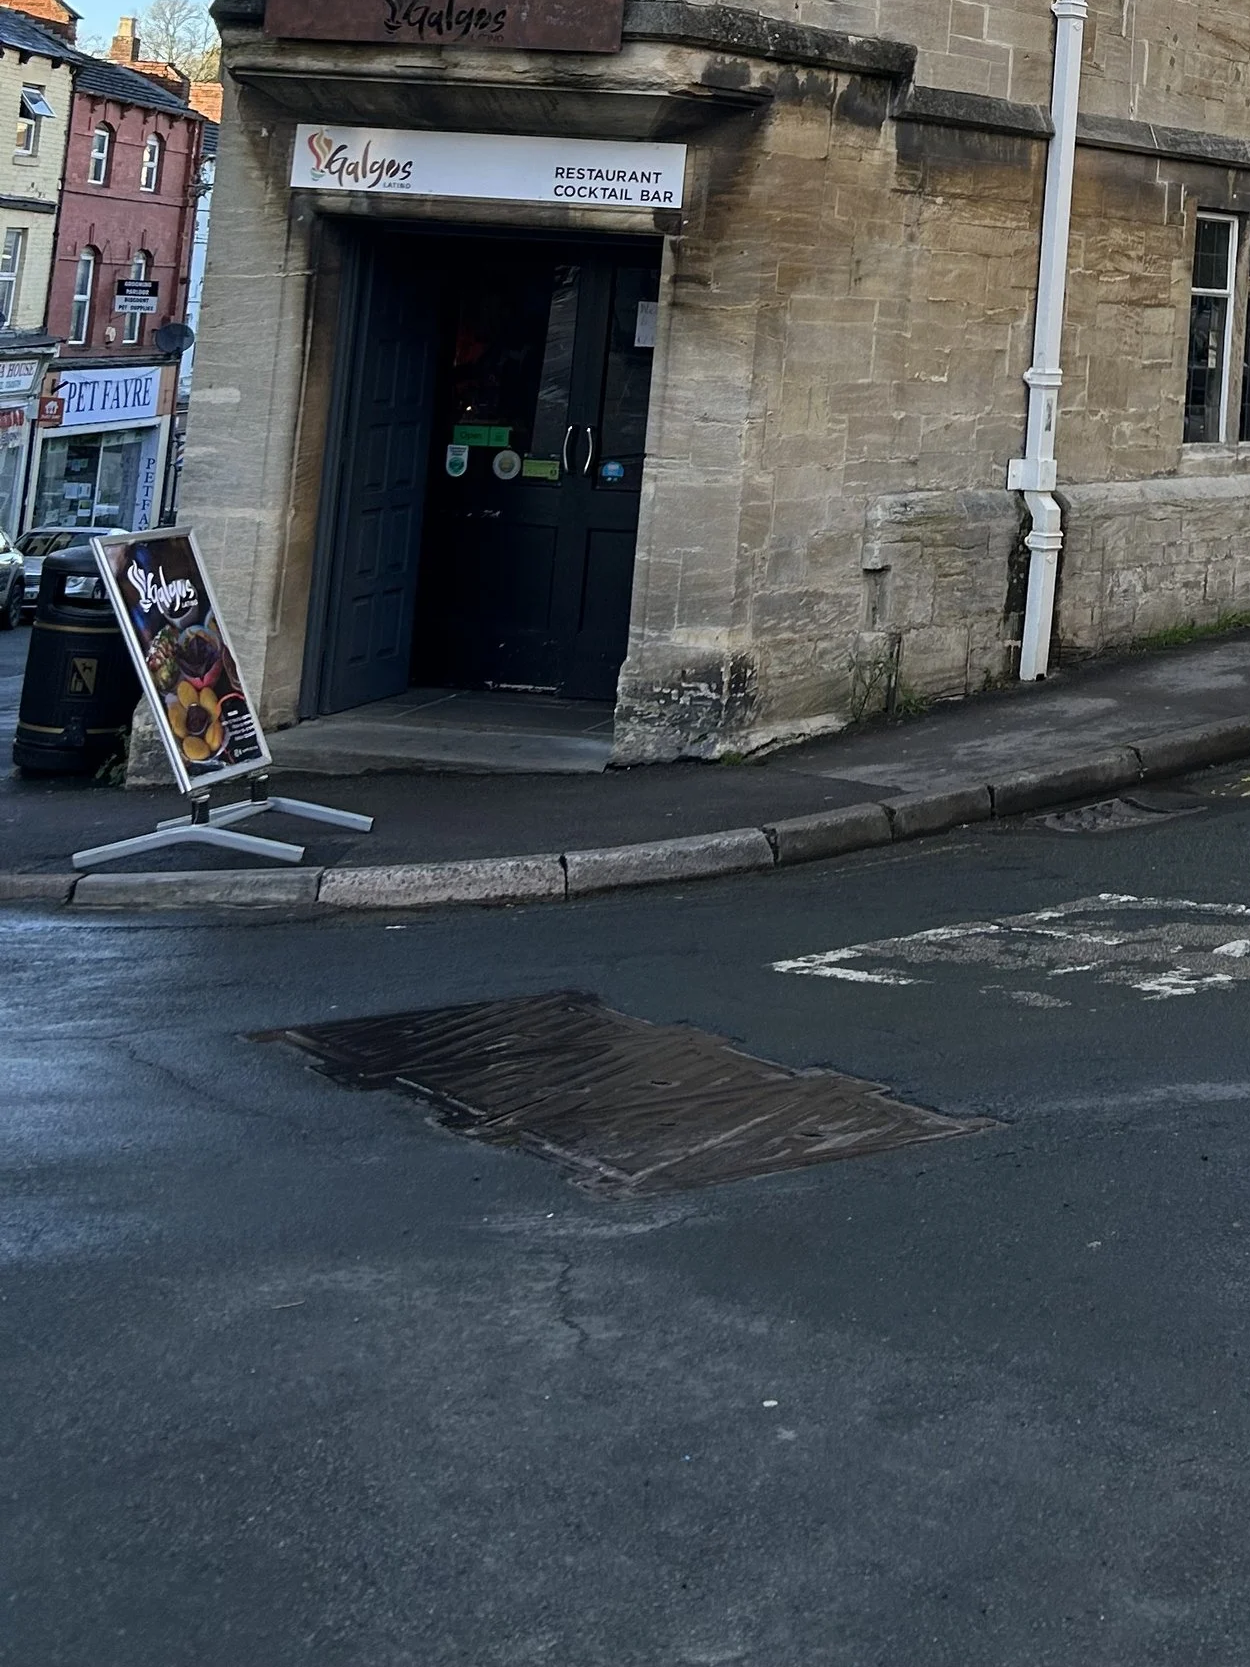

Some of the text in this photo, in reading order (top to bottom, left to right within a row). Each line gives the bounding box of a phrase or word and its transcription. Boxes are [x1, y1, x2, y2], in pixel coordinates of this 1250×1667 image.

[325, 140, 413, 189] Galgos
[555, 167, 662, 184] RESTAURANT
[554, 185, 674, 203] COCKTAIL BAR
[6, 362, 37, 378] HOUSE
[66, 377, 153, 413] PET FAYRE
[147, 566, 195, 614] Galgos
